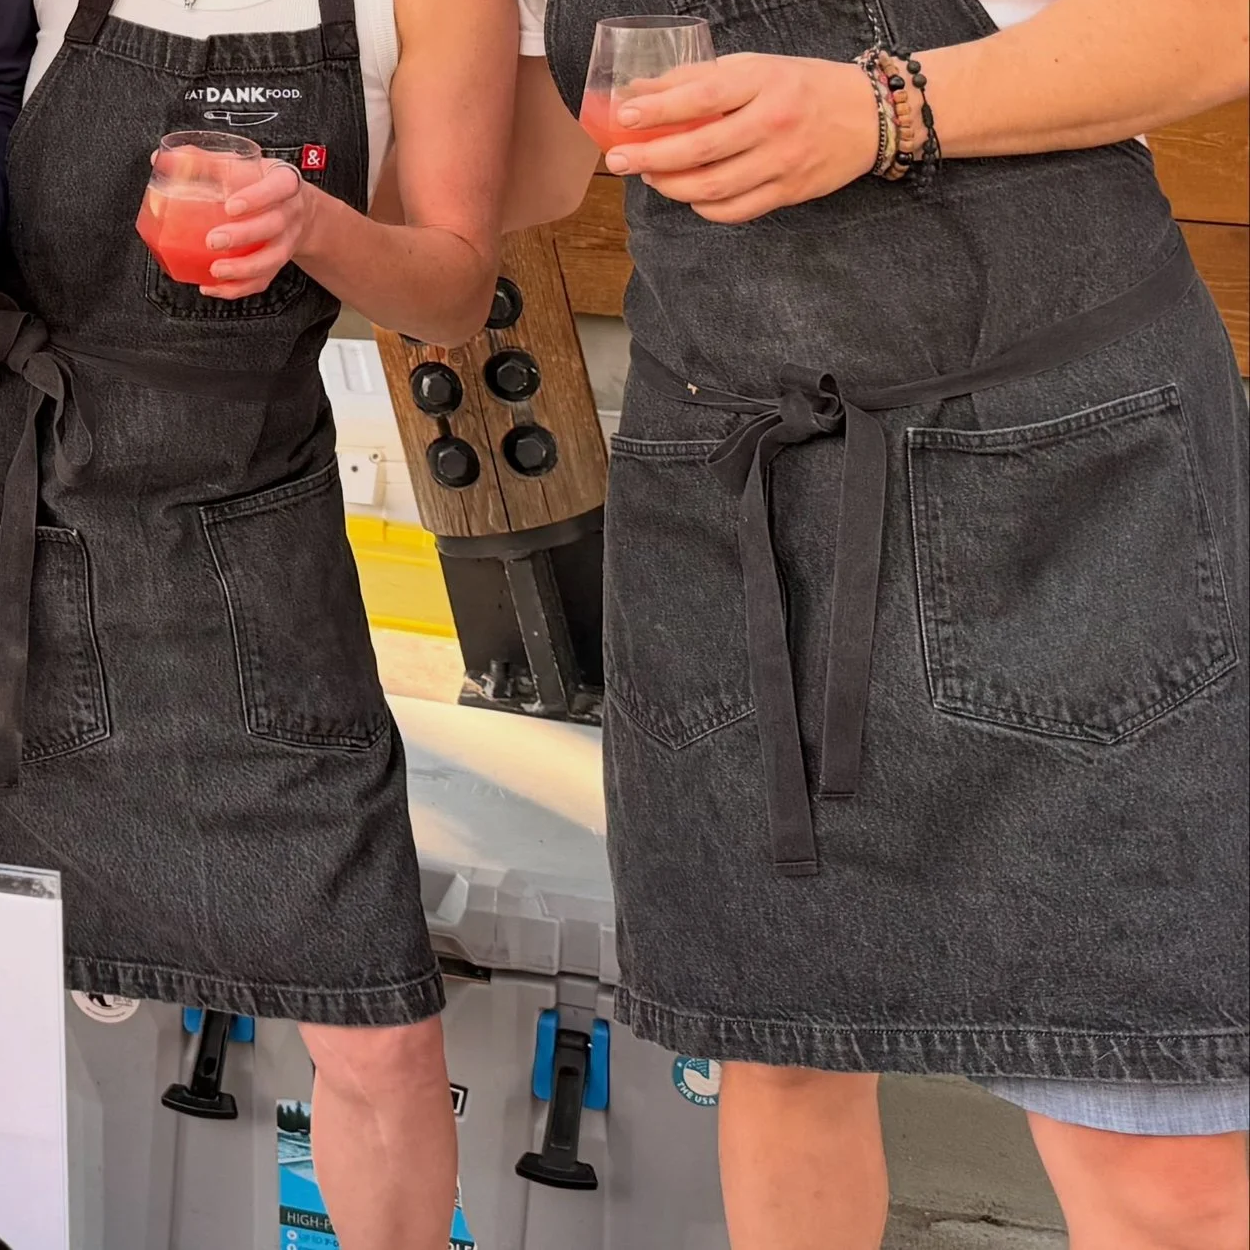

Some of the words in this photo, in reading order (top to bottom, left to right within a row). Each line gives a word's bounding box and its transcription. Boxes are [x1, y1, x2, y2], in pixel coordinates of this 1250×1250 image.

[206, 87, 267, 103] DANK
[306, 148, 321, 166] &
[677, 1081, 694, 1100] THE
[694, 1095, 717, 1105] USA
